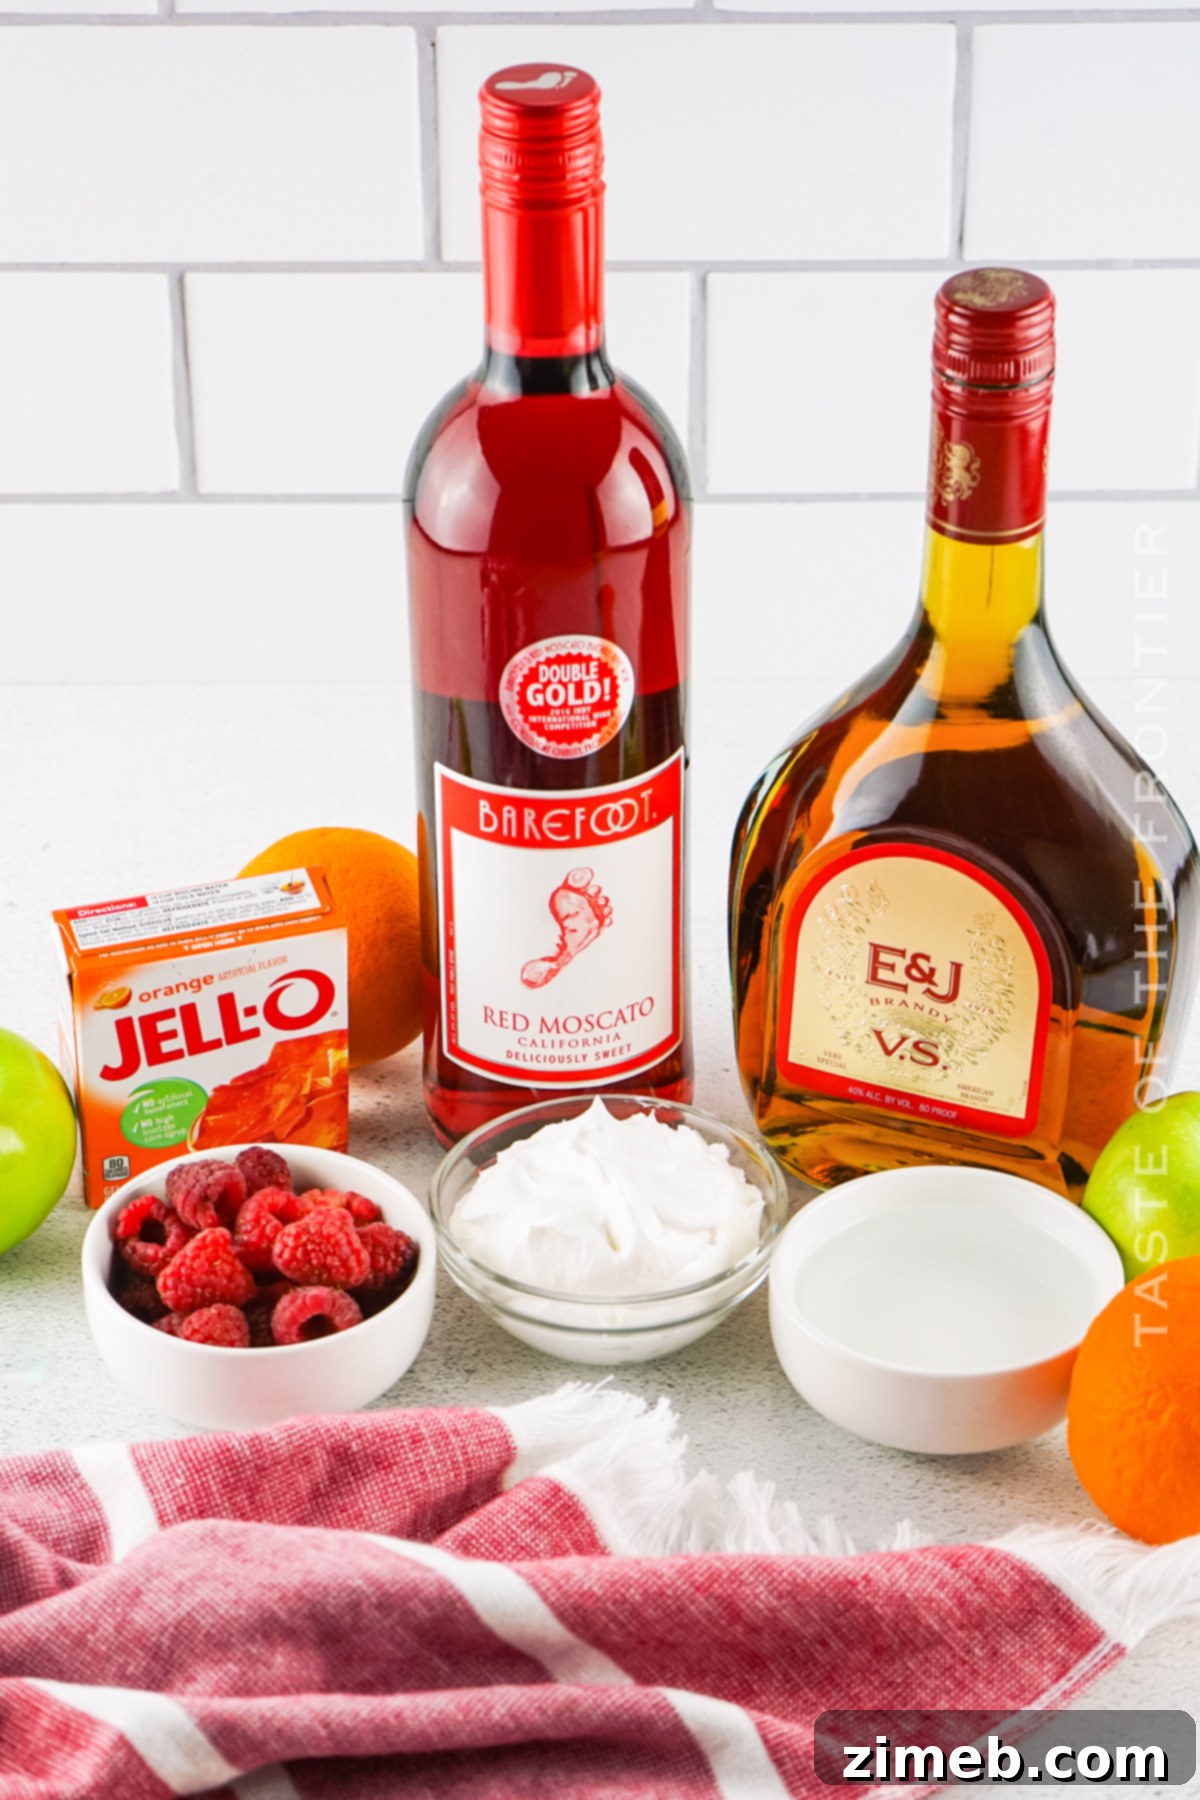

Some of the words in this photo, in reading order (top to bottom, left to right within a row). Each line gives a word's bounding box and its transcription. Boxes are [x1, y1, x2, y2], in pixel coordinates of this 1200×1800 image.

[539, 661, 599, 683] DOUBLE
[526, 677, 611, 707] GOLD!
[529, 714, 590, 724] INTERNATIONAL
[544, 721, 598, 731] COMPETITION
[479, 788, 653, 841] BAREFOOT
[77, 902, 137, 918] Directions:
[139, 974, 215, 1003] orange
[217, 964, 257, 982] ARTIFICIAL
[259, 954, 288, 971] FLAVOR
[865, 942, 964, 1005] E&J
[483, 1005, 530, 1032] RED
[538, 997, 655, 1035] MOSCATO
[869, 997, 954, 1024] BRANDY
[100, 969, 336, 1082] JELL-O
[517, 1032, 621, 1049] CALIFORNIA
[871, 1028, 948, 1071] V.S.
[506, 1050, 588, 1064] DELICIOUSLY
[594, 1044, 632, 1061] SWEET
[816, 1056, 847, 1070] SPECIAL
[957, 1083, 994, 1096] AMERICAN
[142, 1098, 155, 1109] NO
[884, 1095, 895, 1104] BY
[919, 1103, 930, 1113] 80
[931, 1107, 958, 1119] PROOF
[141, 1118, 153, 1129] NO
[109, 1157, 124, 1168] 80
